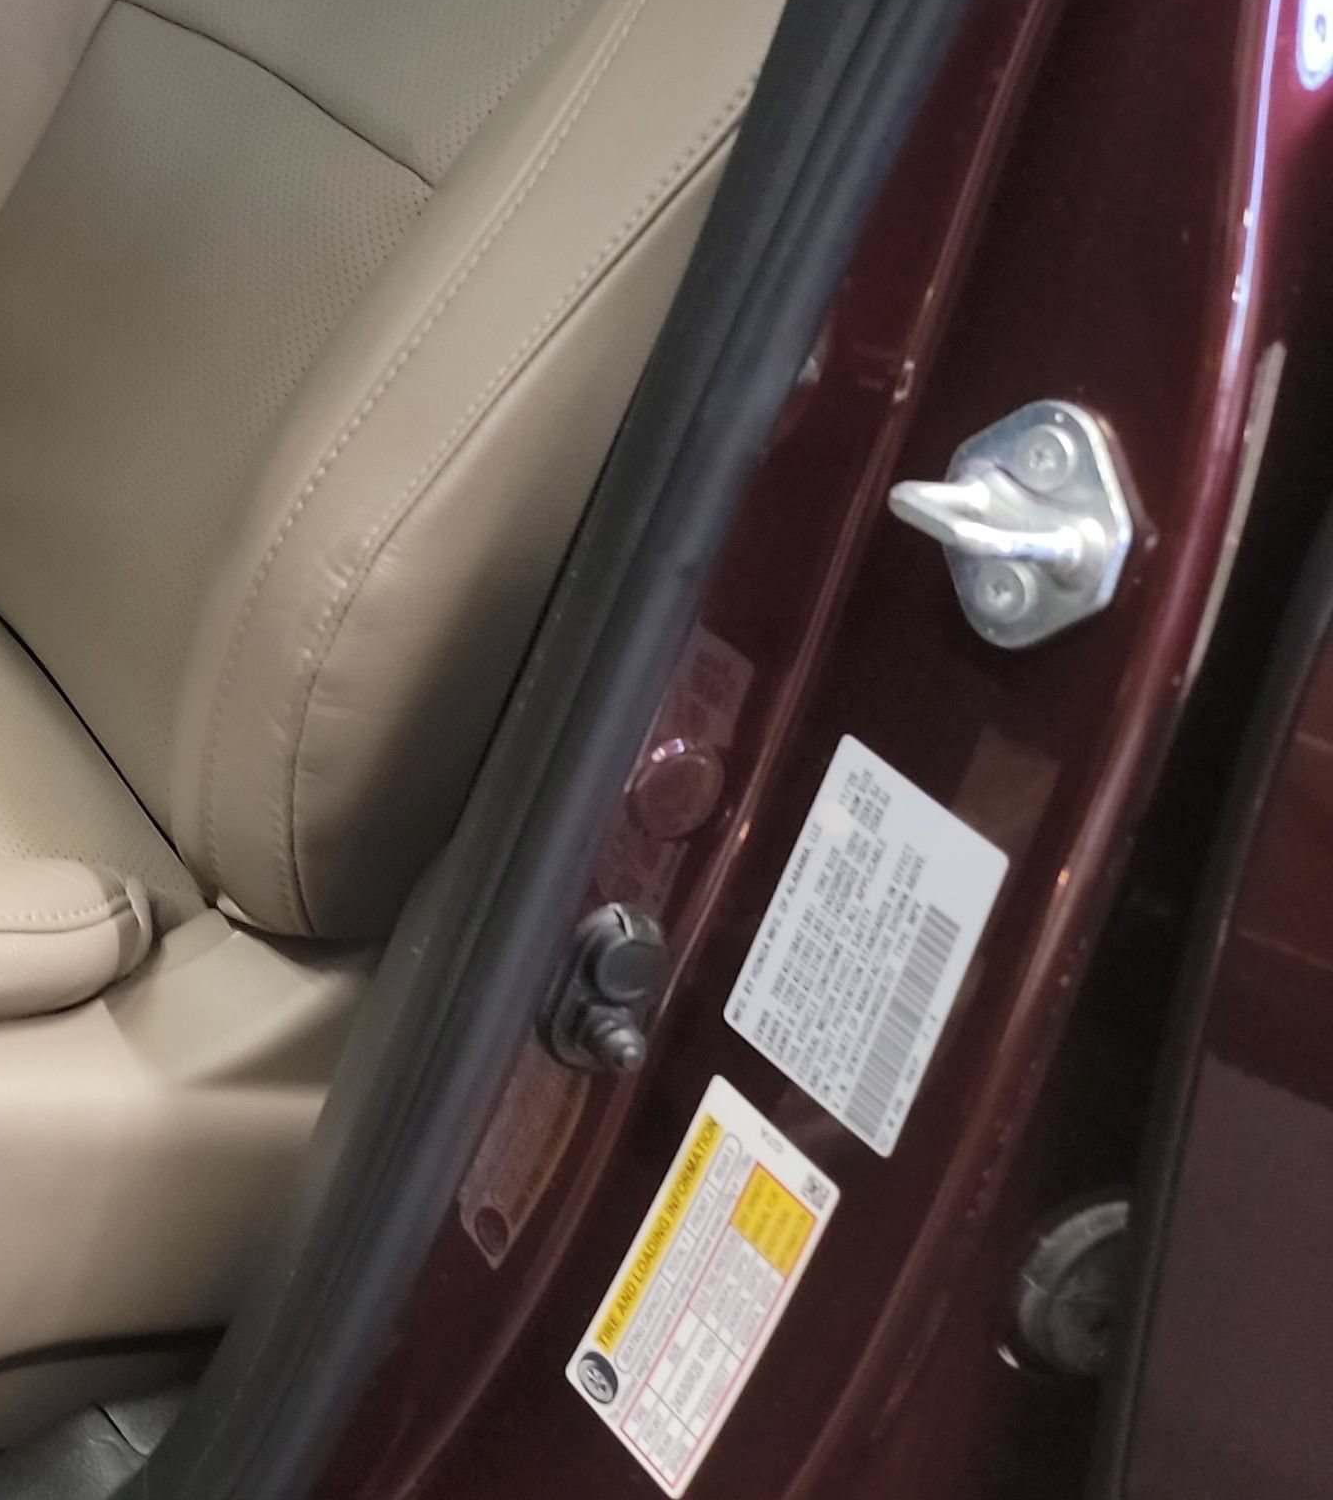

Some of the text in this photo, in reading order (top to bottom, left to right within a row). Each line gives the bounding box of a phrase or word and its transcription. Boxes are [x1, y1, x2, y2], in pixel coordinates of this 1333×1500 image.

[596, 1314, 620, 1352] TIRE
[613, 1278, 638, 1318] AND
[629, 1212, 672, 1284] LOADING
[660, 1113, 722, 1219] INFORMATION
